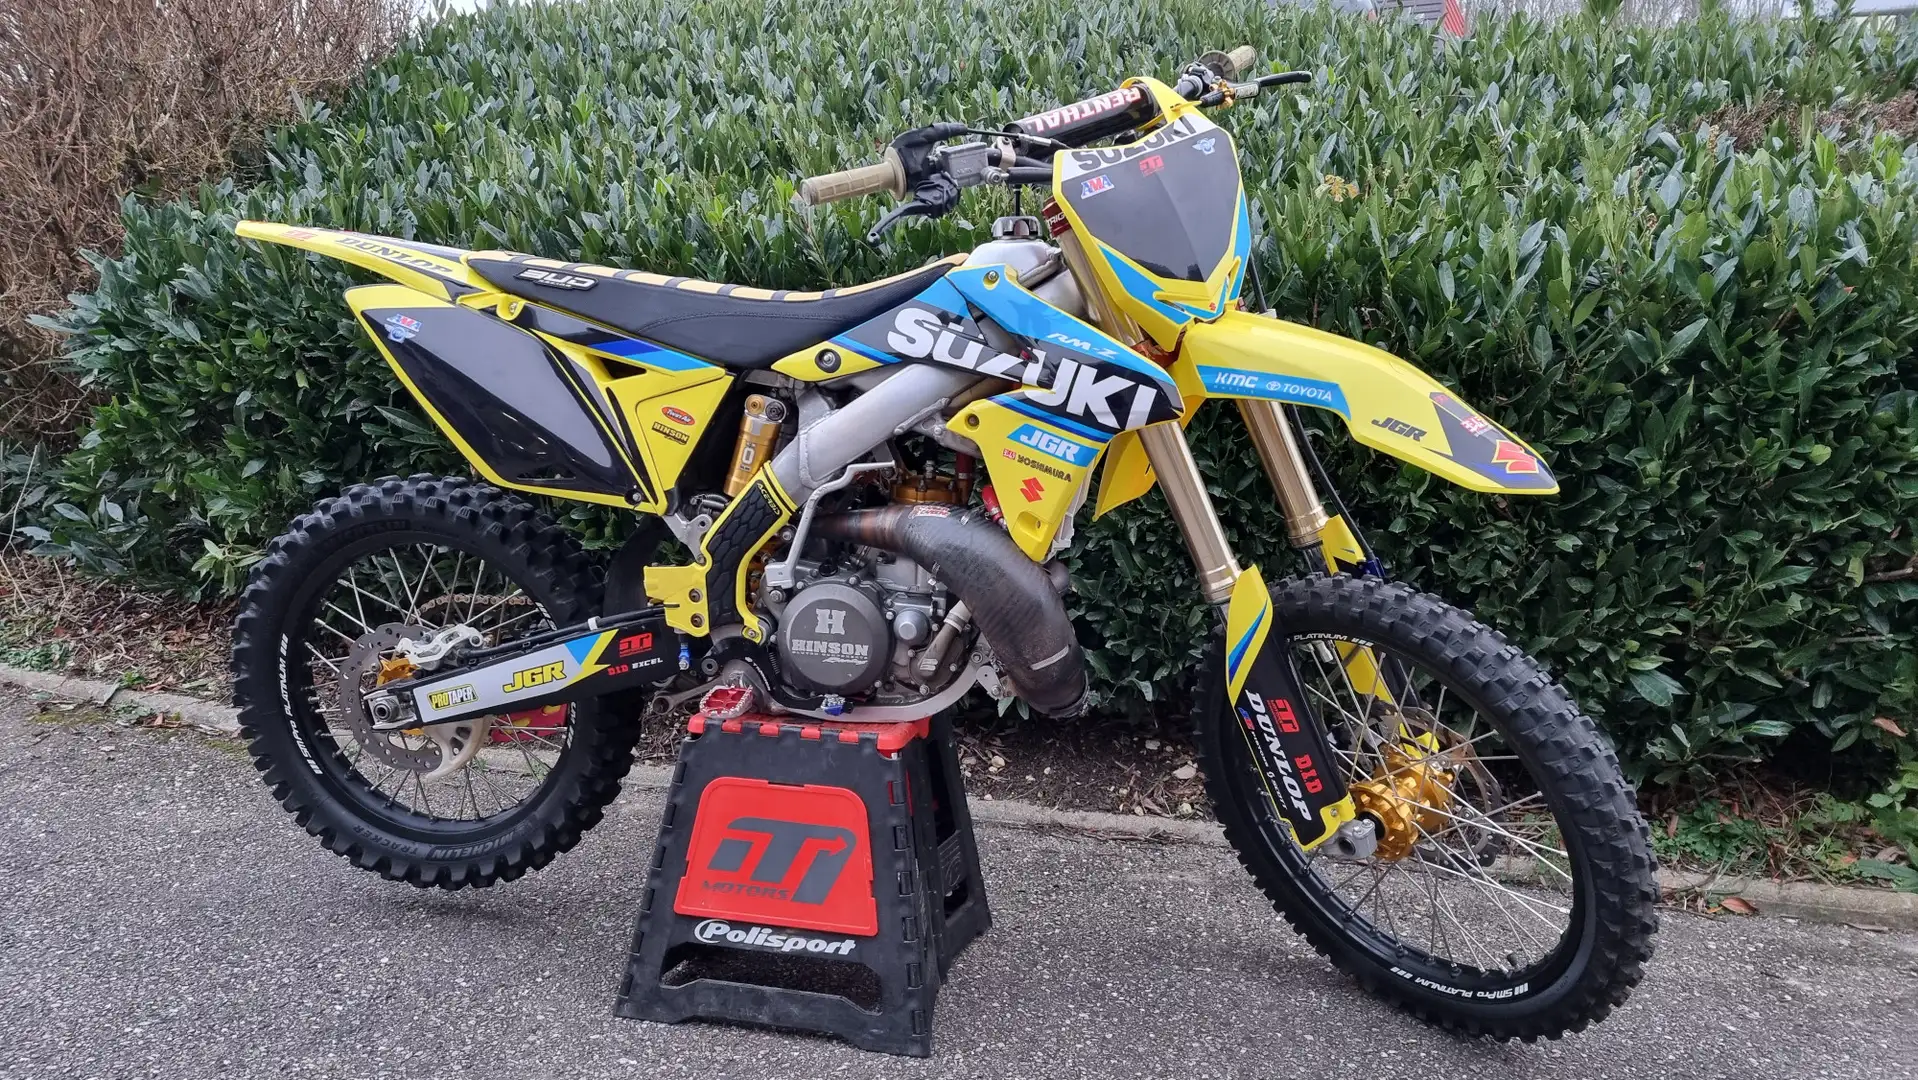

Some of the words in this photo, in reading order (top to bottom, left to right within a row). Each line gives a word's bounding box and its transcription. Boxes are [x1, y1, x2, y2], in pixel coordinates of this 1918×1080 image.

[1025, 87, 1141, 132] RENTHAL
[1082, 175, 1113, 198] AMA
[336, 237, 453, 273] DUNLOP
[1046, 333, 1120, 360] RM-Z
[887, 308, 1157, 431] SUZUKI
[1215, 372, 1258, 388] KMC
[1283, 383, 1332, 402] TOYOTA
[653, 422, 689, 442] HINSON
[1371, 417, 1427, 442] JGR
[1020, 429, 1081, 462] JGR
[1017, 454, 1072, 483] YOSHIMURA
[791, 639, 869, 656] HINSON
[1293, 632, 1348, 641] PLATINUM
[502, 660, 567, 693] JGR
[632, 657, 663, 669] EXCEL
[279, 656, 293, 717] PLATINUM
[1245, 689, 1312, 821] DUNLOP
[353, 824, 418, 855] TRACKER
[431, 829, 515, 860] MICHELIN
[702, 880, 791, 900] MOTORS
[694, 919, 856, 955] Polisport
[1415, 977, 1473, 998] PLATINUM
